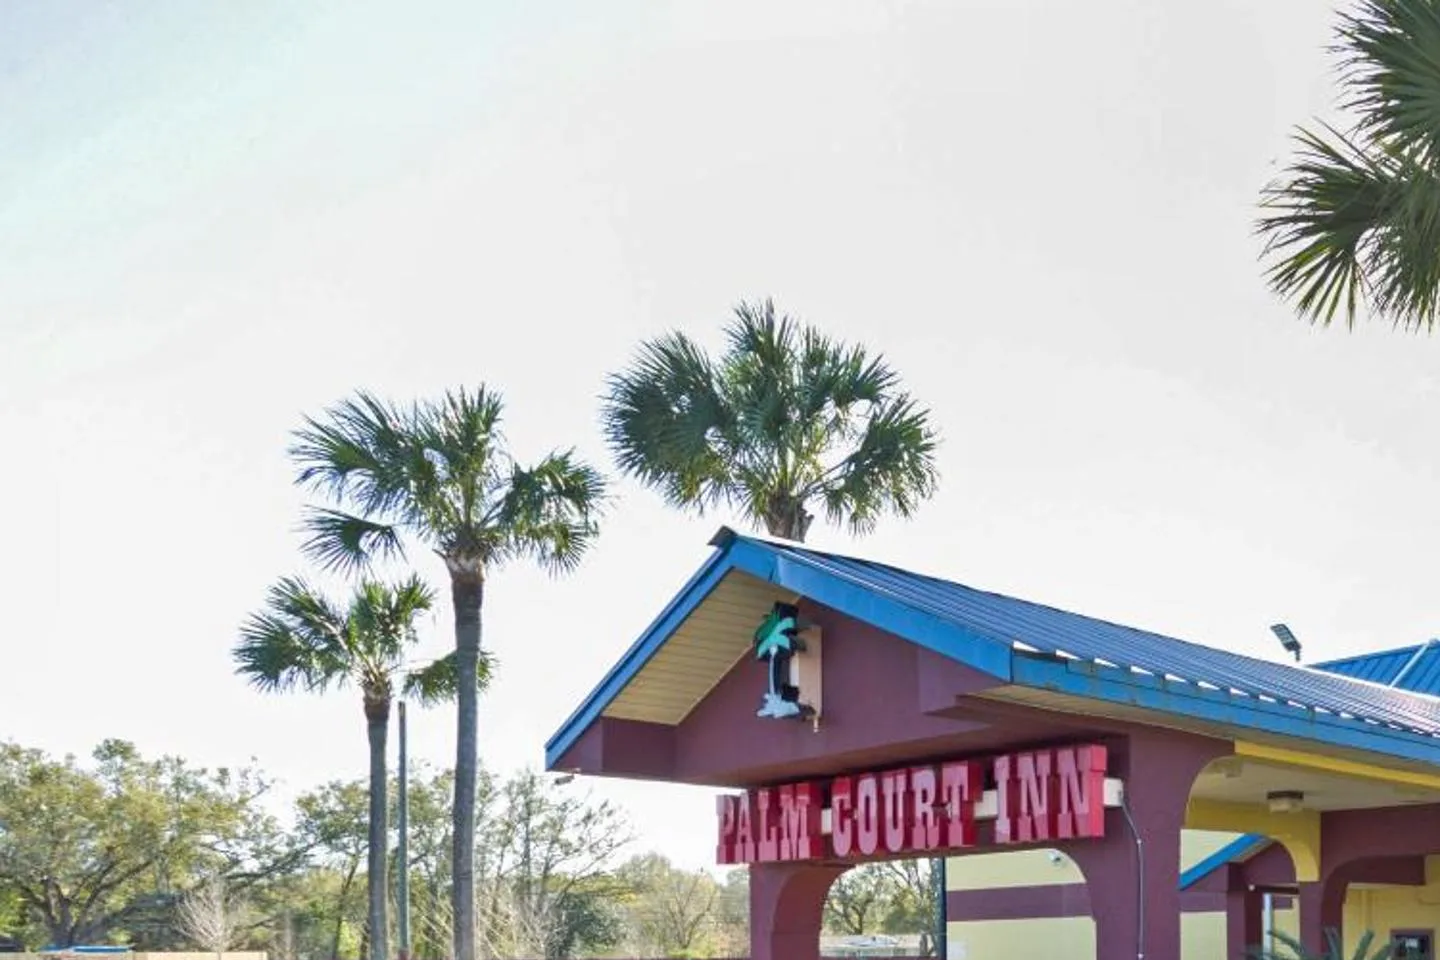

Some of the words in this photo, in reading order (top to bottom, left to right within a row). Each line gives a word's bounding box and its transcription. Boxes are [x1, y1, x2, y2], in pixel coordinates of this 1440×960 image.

[716, 786, 814, 865] PALM
[831, 760, 970, 857] COURT
[994, 745, 1098, 844] INN
